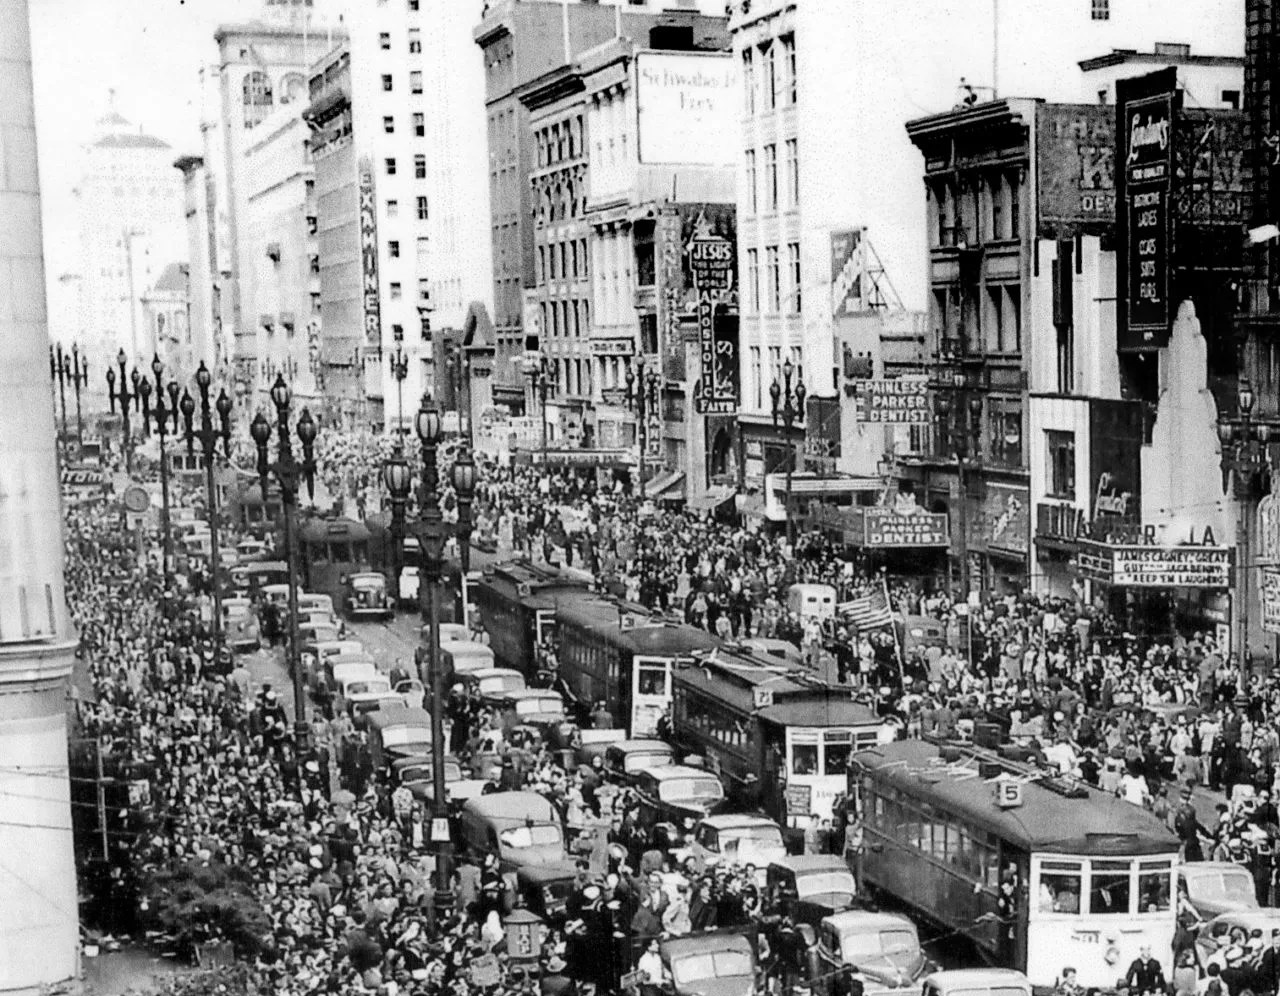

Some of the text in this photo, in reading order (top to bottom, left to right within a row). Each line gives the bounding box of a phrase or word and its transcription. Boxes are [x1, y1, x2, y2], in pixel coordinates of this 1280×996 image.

[360, 170, 380, 342] EXAMINER
[693, 244, 732, 260] JESUS
[700, 290, 712, 397] APOSTOLIC
[865, 381, 928, 395] PAINLESS
[700, 400, 735, 412] FAITH
[872, 395, 926, 408] PARKER
[869, 409, 928, 422] DENTIST
[871, 533, 943, 544] DENTIST
[1117, 551, 1150, 562] JAMES
[1005, 785, 1018, 801] 5
